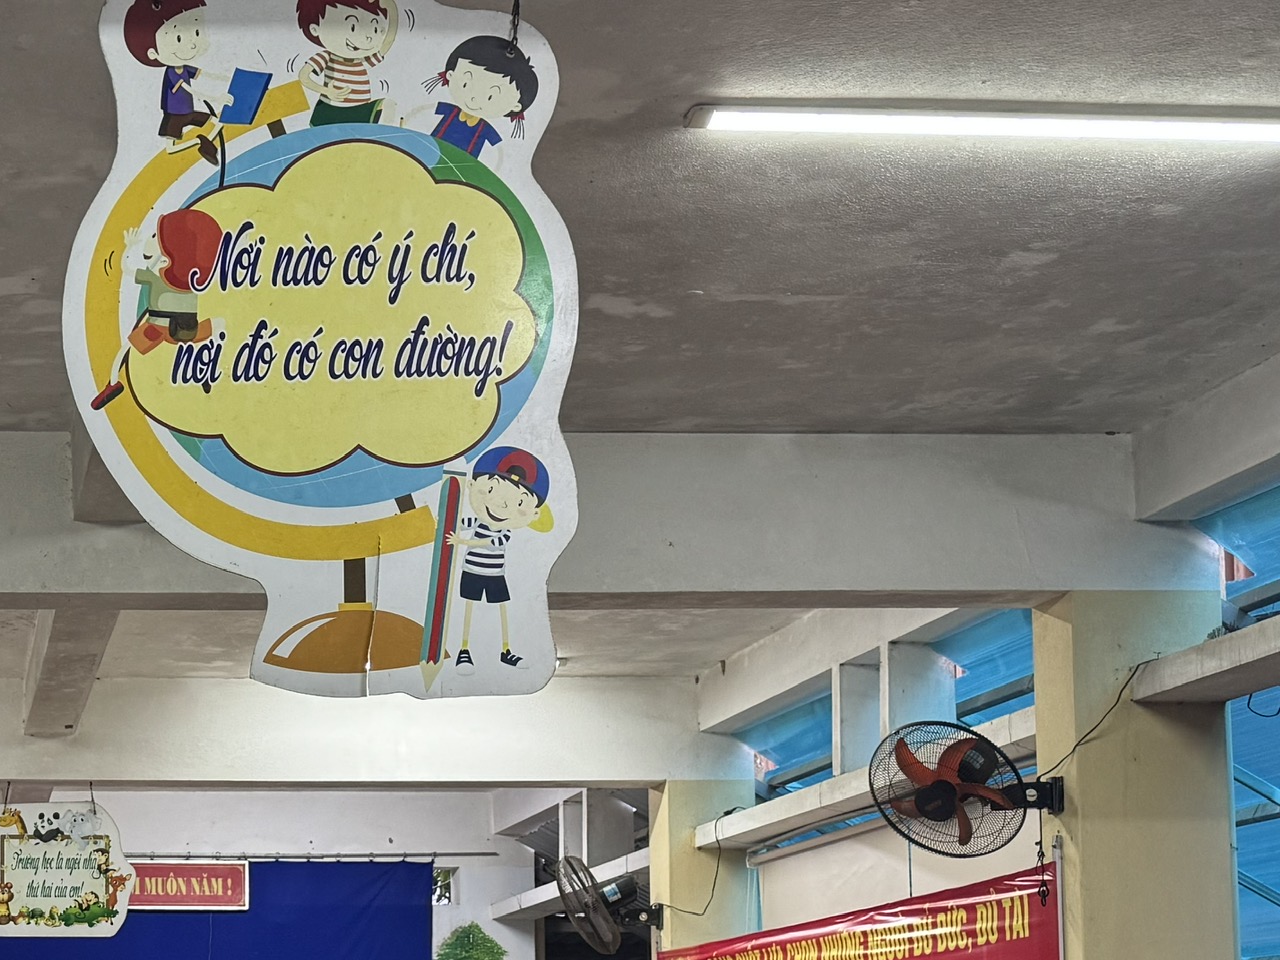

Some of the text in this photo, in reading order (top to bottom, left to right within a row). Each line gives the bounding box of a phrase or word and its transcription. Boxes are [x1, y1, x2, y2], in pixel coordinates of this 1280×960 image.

[191, 221, 476, 304] Nơi nào có ý chí,
[232, 320, 278, 383] đó
[284, 327, 324, 381] có
[328, 338, 384, 380] con
[394, 316, 514, 398] đường!
[144, 872, 186, 895] MUÔN
[191, 873, 223, 895] NĂM
